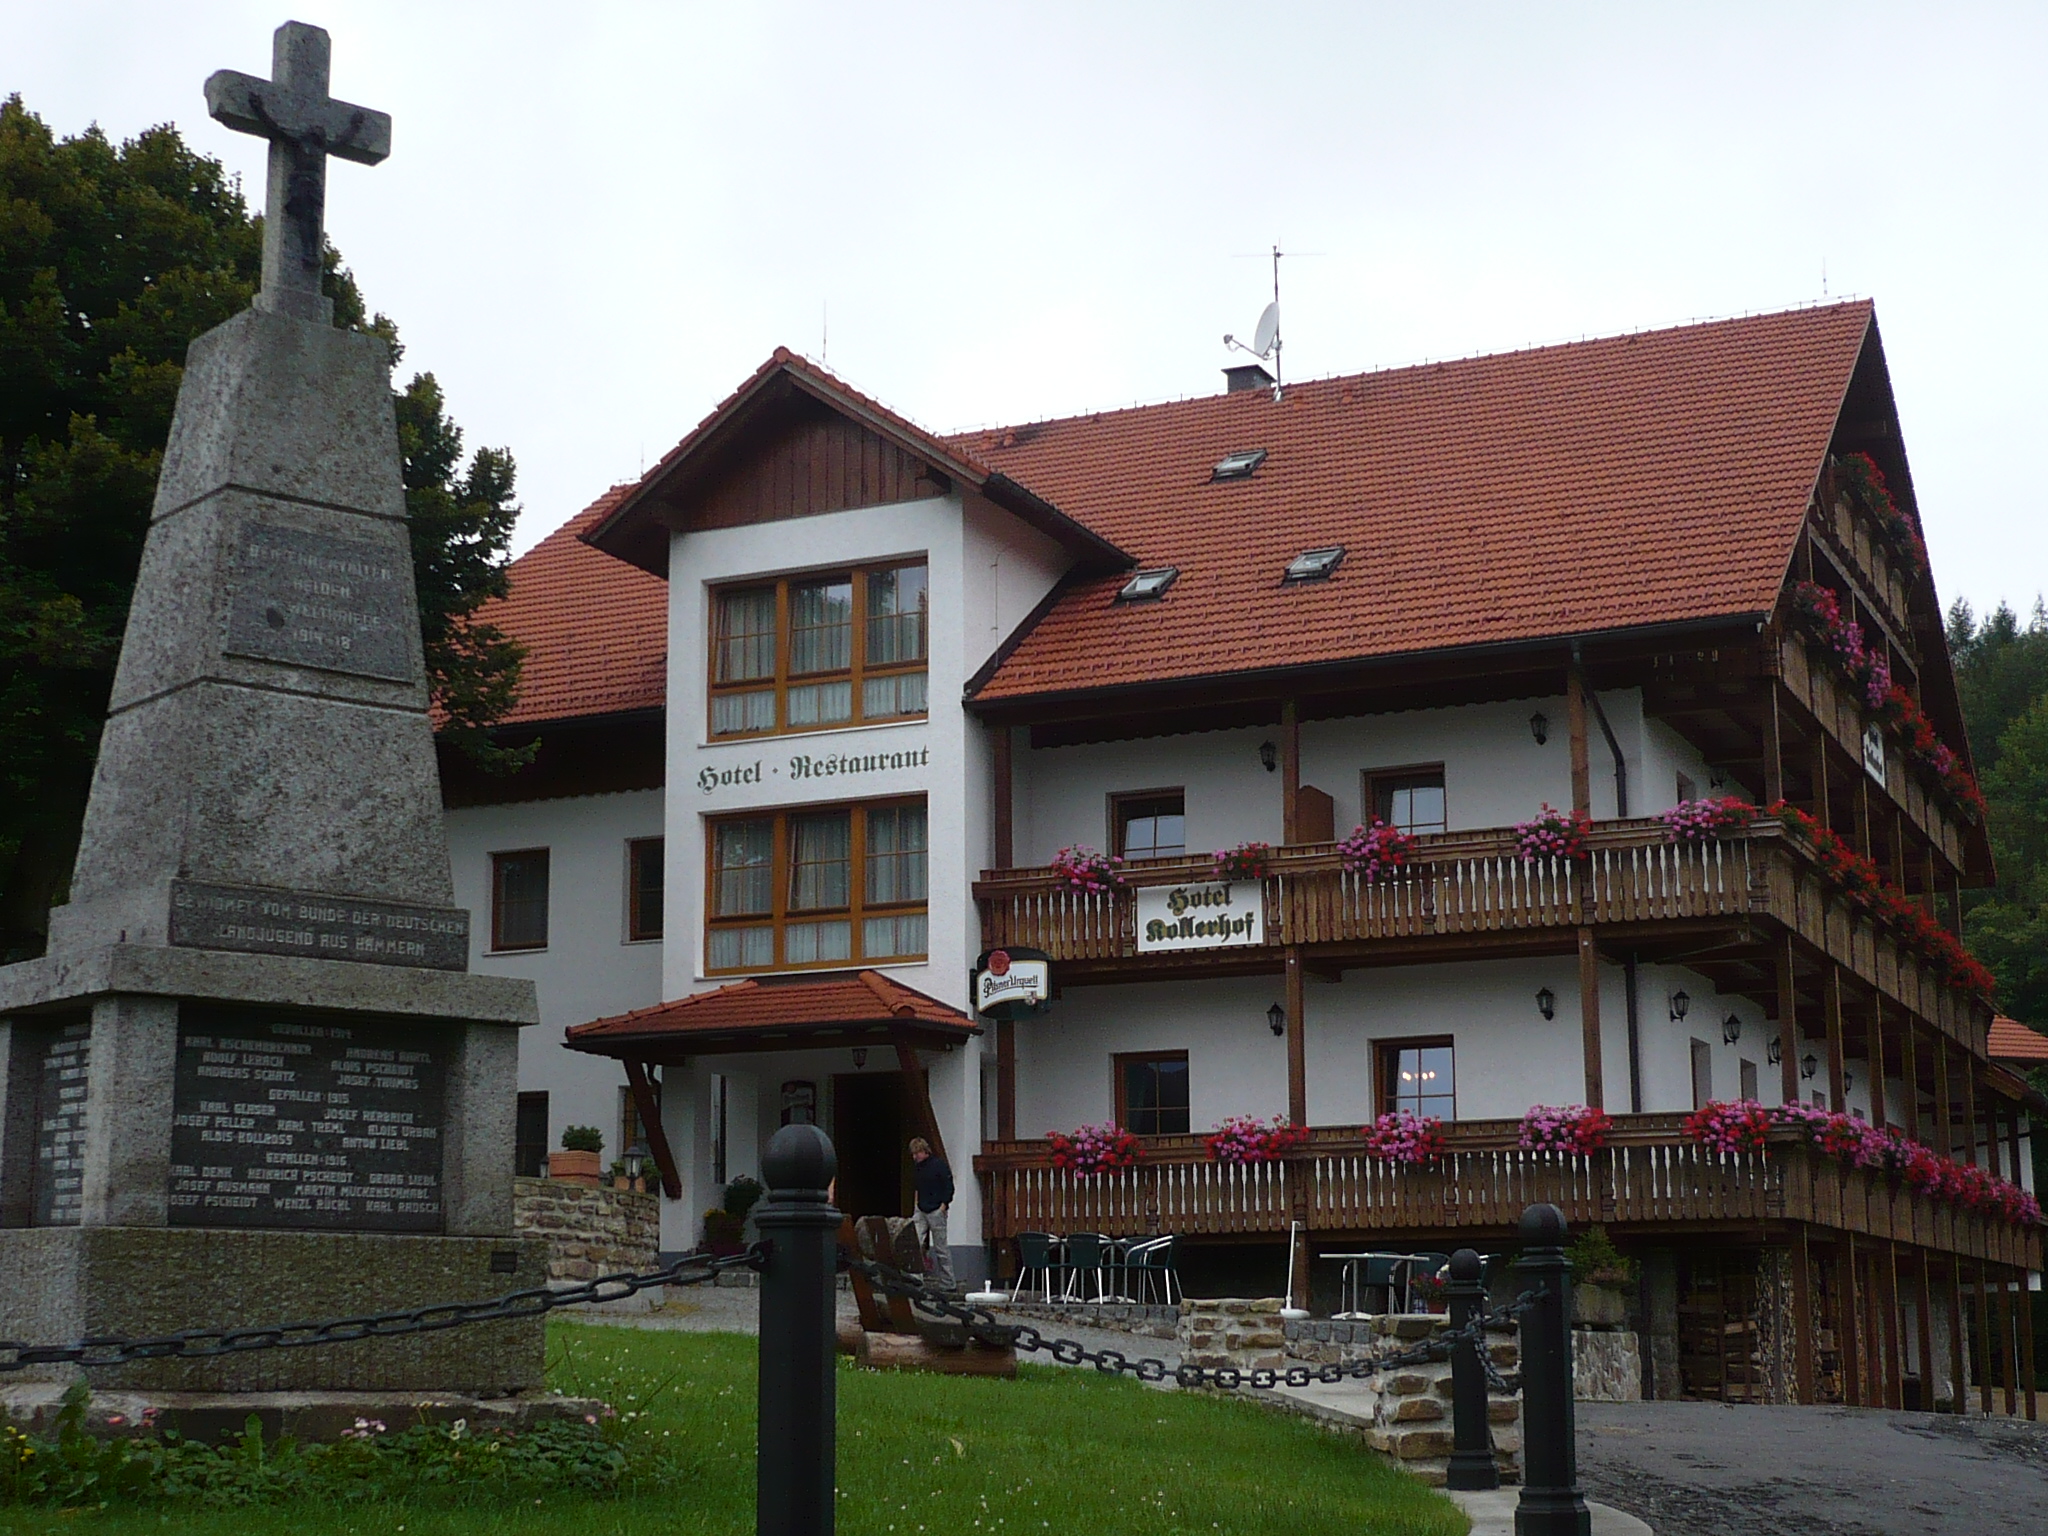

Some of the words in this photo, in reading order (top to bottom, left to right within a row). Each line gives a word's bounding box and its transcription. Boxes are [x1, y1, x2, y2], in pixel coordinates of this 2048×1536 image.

[697, 760, 762, 795] Hotel
[790, 745, 929, 780] Restaurant
[1166, 883, 1233, 916] Hotel
[262, 901, 290, 920] VOM
[300, 906, 346, 923] BUNDE
[352, 910, 380, 926] DER
[386, 914, 464, 934] DEUTSCHEN
[1145, 912, 1254, 943] Kollerhof
[216, 926, 313, 946] LANDJUGEND
[320, 934, 348, 949] AUS
[983, 978, 1010, 998] Pilsner
[1010, 974, 1038, 990] Urquell
[337, 1074, 371, 1087] JOSEF
[269, 1089, 322, 1102] GEFALLEN
[327, 1092, 349, 1104] 1915
[200, 1100, 230, 1113] KARL
[173, 1114, 210, 1127] JOSEF
[214, 1116, 255, 1129] PELLER
[324, 1108, 357, 1121] JOSEF
[277, 1119, 306, 1131] KARL
[311, 1121, 347, 1134] TREML
[367, 1123, 398, 1137] ALOIS
[201, 1130, 235, 1142] ALOIS
[265, 1152, 319, 1165] GEFALLEN
[175, 1180, 212, 1192] JOSEF
[365, 1201, 393, 1212] KARL
